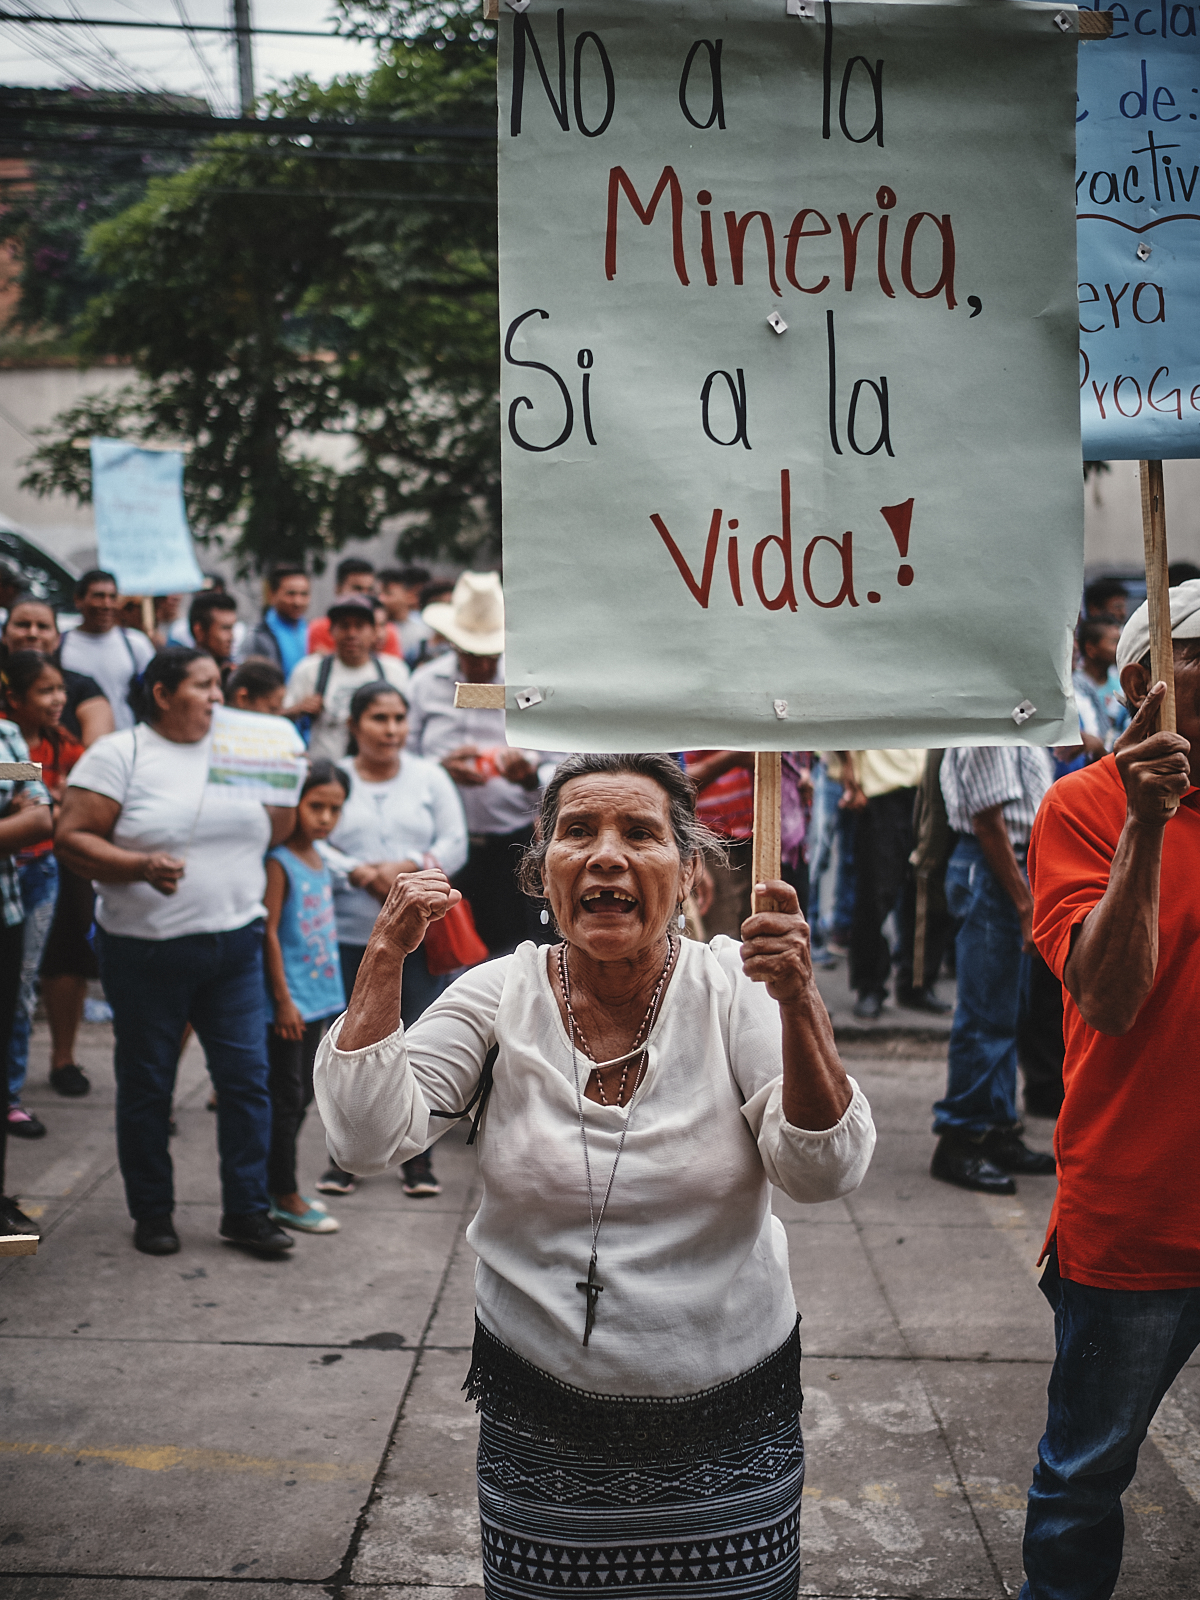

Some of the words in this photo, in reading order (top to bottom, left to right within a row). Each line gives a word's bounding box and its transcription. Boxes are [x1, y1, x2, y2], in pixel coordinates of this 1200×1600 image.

[510, 7, 615, 138] No
[678, 38, 727, 130] a
[822, 1, 884, 148] la
[1119, 59, 1198, 122] de:
[605, 165, 983, 319] Mineria,
[503, 308, 597, 452] Si
[700, 368, 752, 450] a
[826, 309, 895, 457] la
[649, 469, 915, 613] Vida.!
